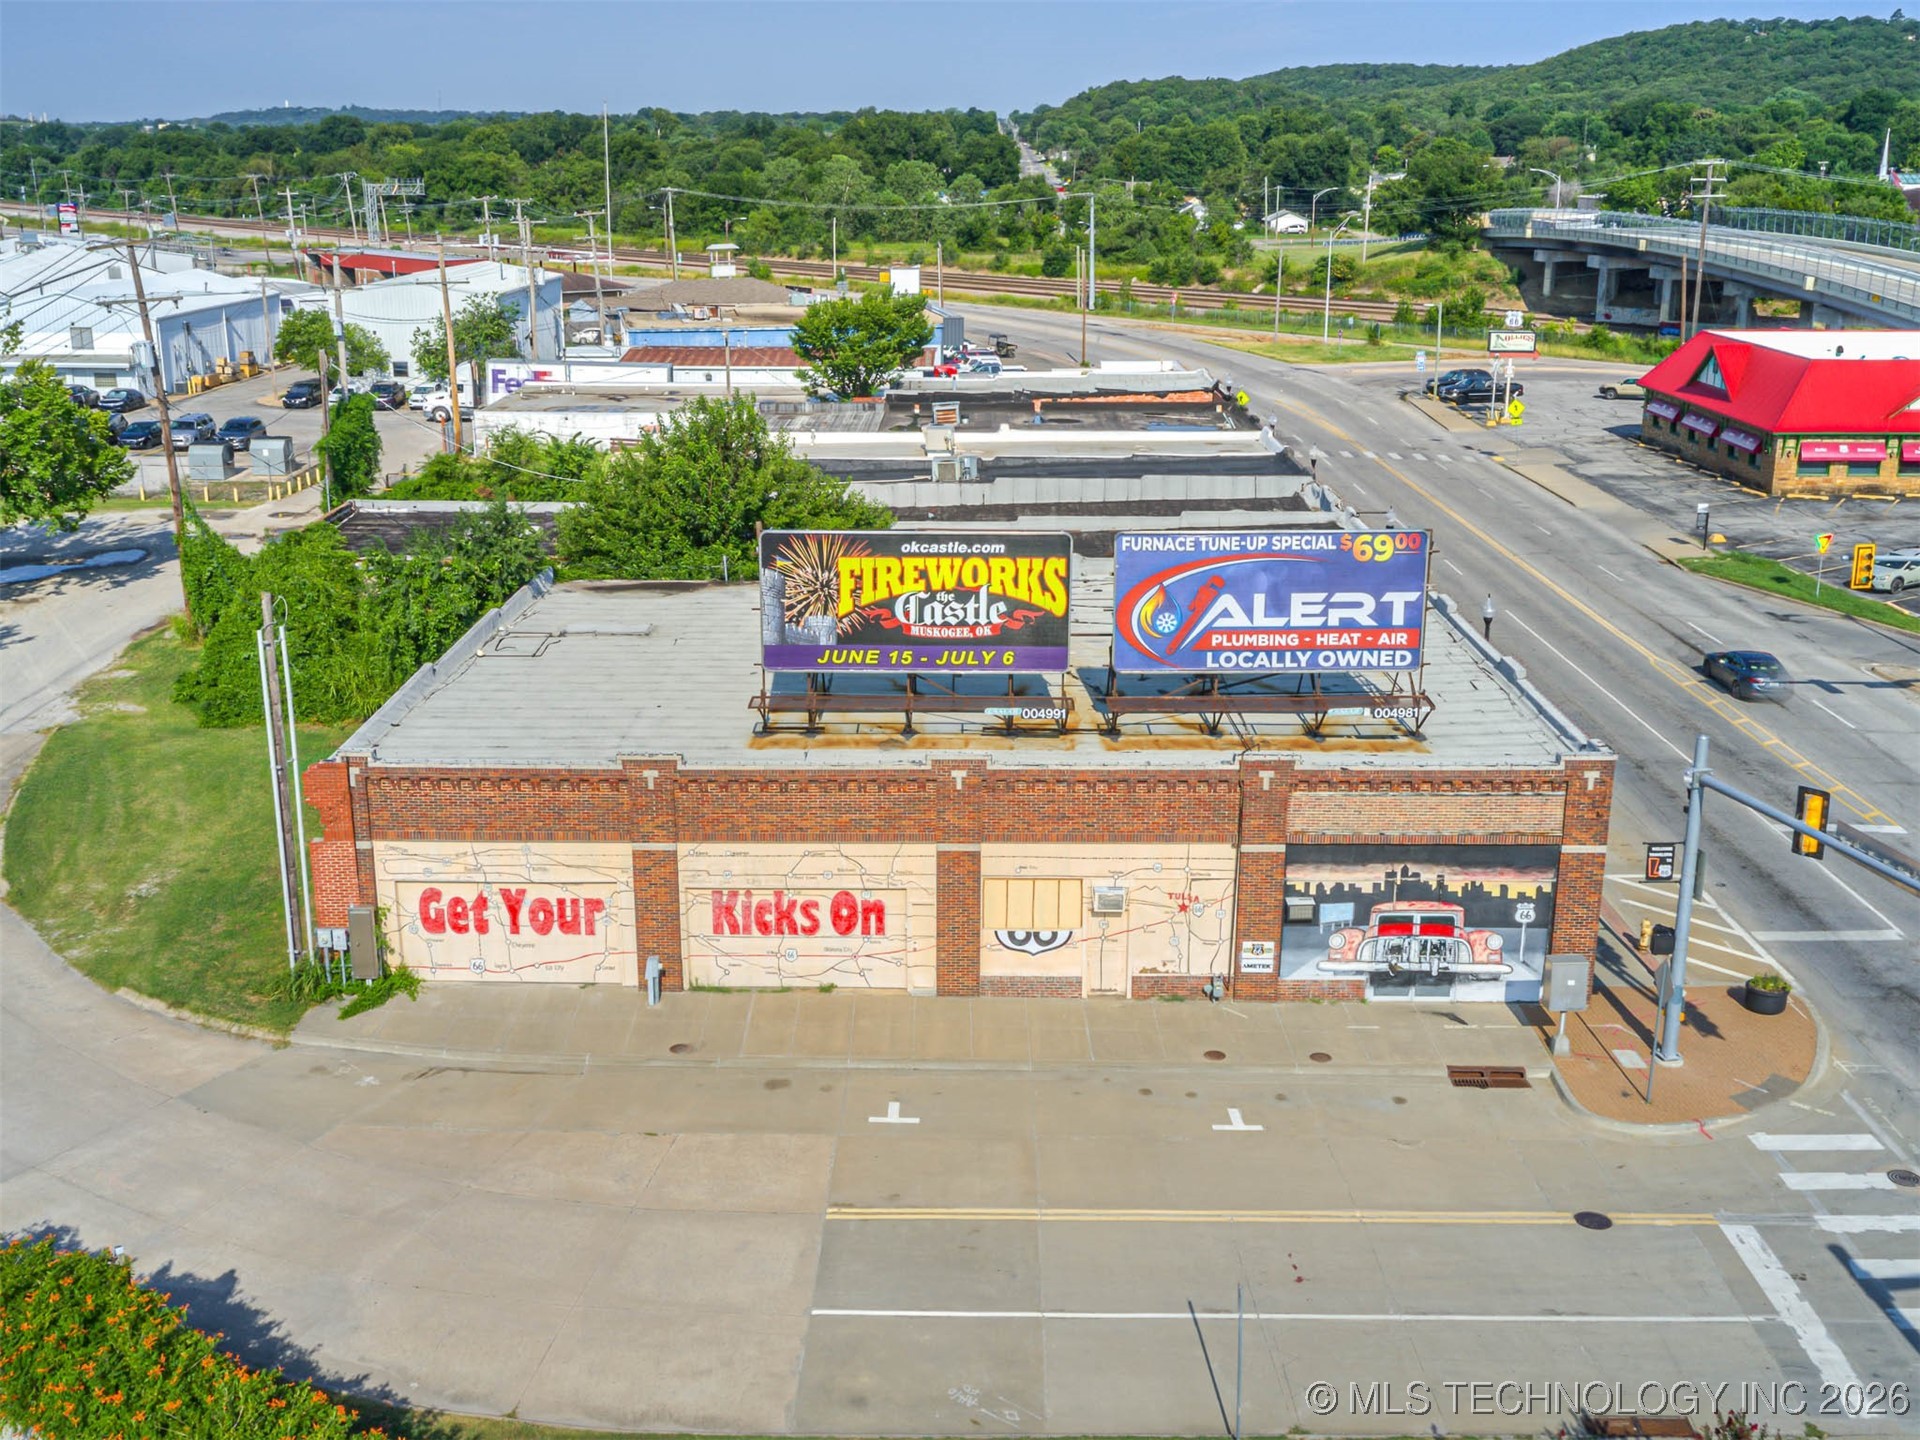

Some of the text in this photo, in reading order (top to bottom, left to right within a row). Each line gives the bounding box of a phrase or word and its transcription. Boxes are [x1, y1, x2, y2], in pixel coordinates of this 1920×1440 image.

[901, 541, 1005, 554] okcastle.com
[1122, 536, 1195, 551] FURNACE
[1200, 536, 1268, 551] TUNE-UP
[1272, 535, 1336, 550] SPECIAL
[837, 556, 1068, 618] FIREWORKS
[937, 592, 955, 603] the
[895, 584, 1007, 626] Castle
[1181, 591, 1422, 648] ALERT
[910, 625, 992, 638] MUSKOGEE, OK
[1211, 633, 1408, 647] PLUMBING HEAT AIR
[817, 649, 880, 664] JUNE
[889, 650, 913, 665] 15
[936, 650, 998, 665] JULY
[1002, 650, 1015, 665] 6
[1207, 650, 1412, 668] LOCALLY OWNED
[1022, 708, 1066, 719] 004991
[1374, 708, 1418, 719] 004981
[1168, 893, 1200, 904] TULSA
[419, 886, 606, 936] Get Your
[711, 889, 886, 936] Kicks On
[1520, 910, 1532, 920] 66
[787, 951, 796, 959] 66
[472, 962, 483, 971] 66
